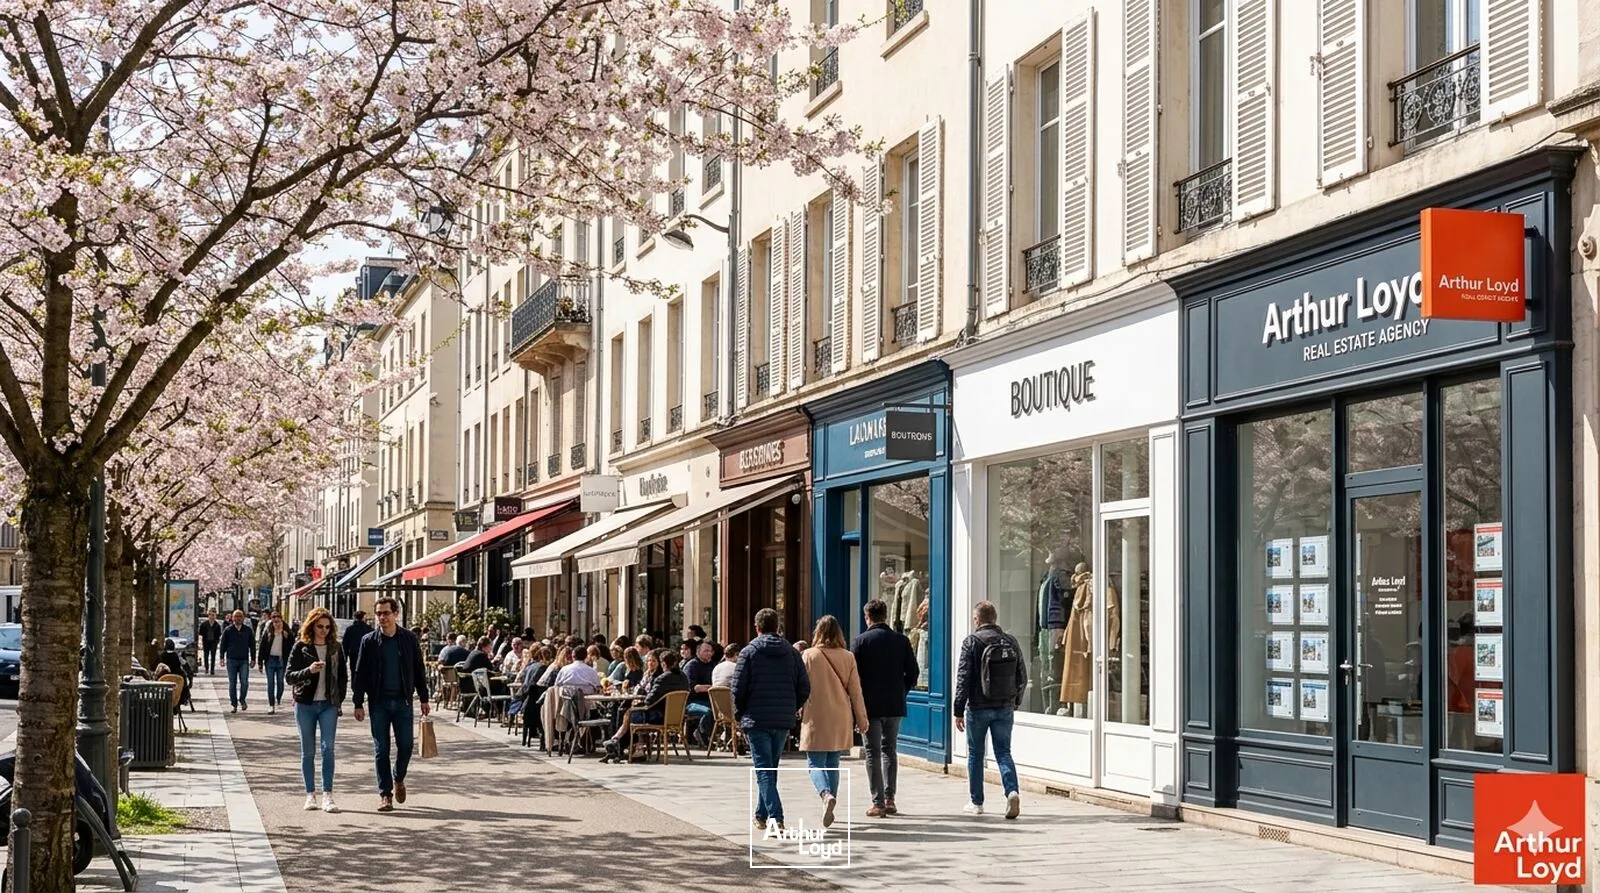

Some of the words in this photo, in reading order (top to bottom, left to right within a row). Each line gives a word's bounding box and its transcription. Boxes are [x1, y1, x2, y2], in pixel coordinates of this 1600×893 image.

[1439, 274, 1483, 290] Arthur
[1486, 277, 1519, 295] Loyd
[1262, 291, 1350, 345] Arthur
[1303, 341, 1331, 361] REAL
[1334, 330, 1376, 355] ESTATE
[1378, 318, 1430, 344] AGENCY
[1011, 359, 1095, 417] BOUTIQUE
[891, 431, 933, 441] BOUTRONS
